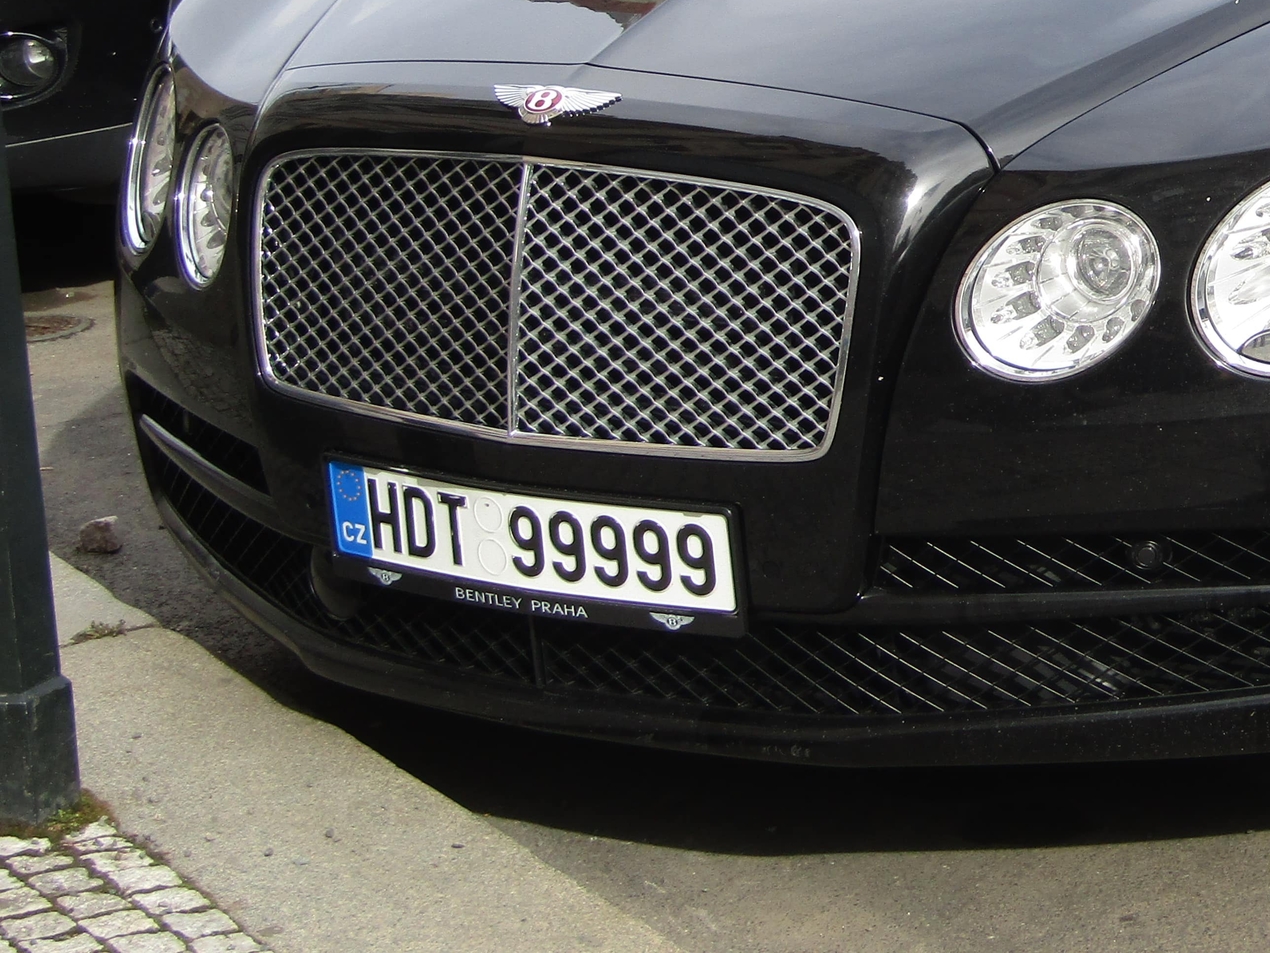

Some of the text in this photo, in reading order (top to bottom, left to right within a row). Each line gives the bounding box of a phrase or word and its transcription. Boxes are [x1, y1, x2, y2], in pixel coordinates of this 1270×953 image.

[342, 477, 717, 596] CZ HDT 99999
[455, 587, 589, 619] BENTLEY PRAHA
